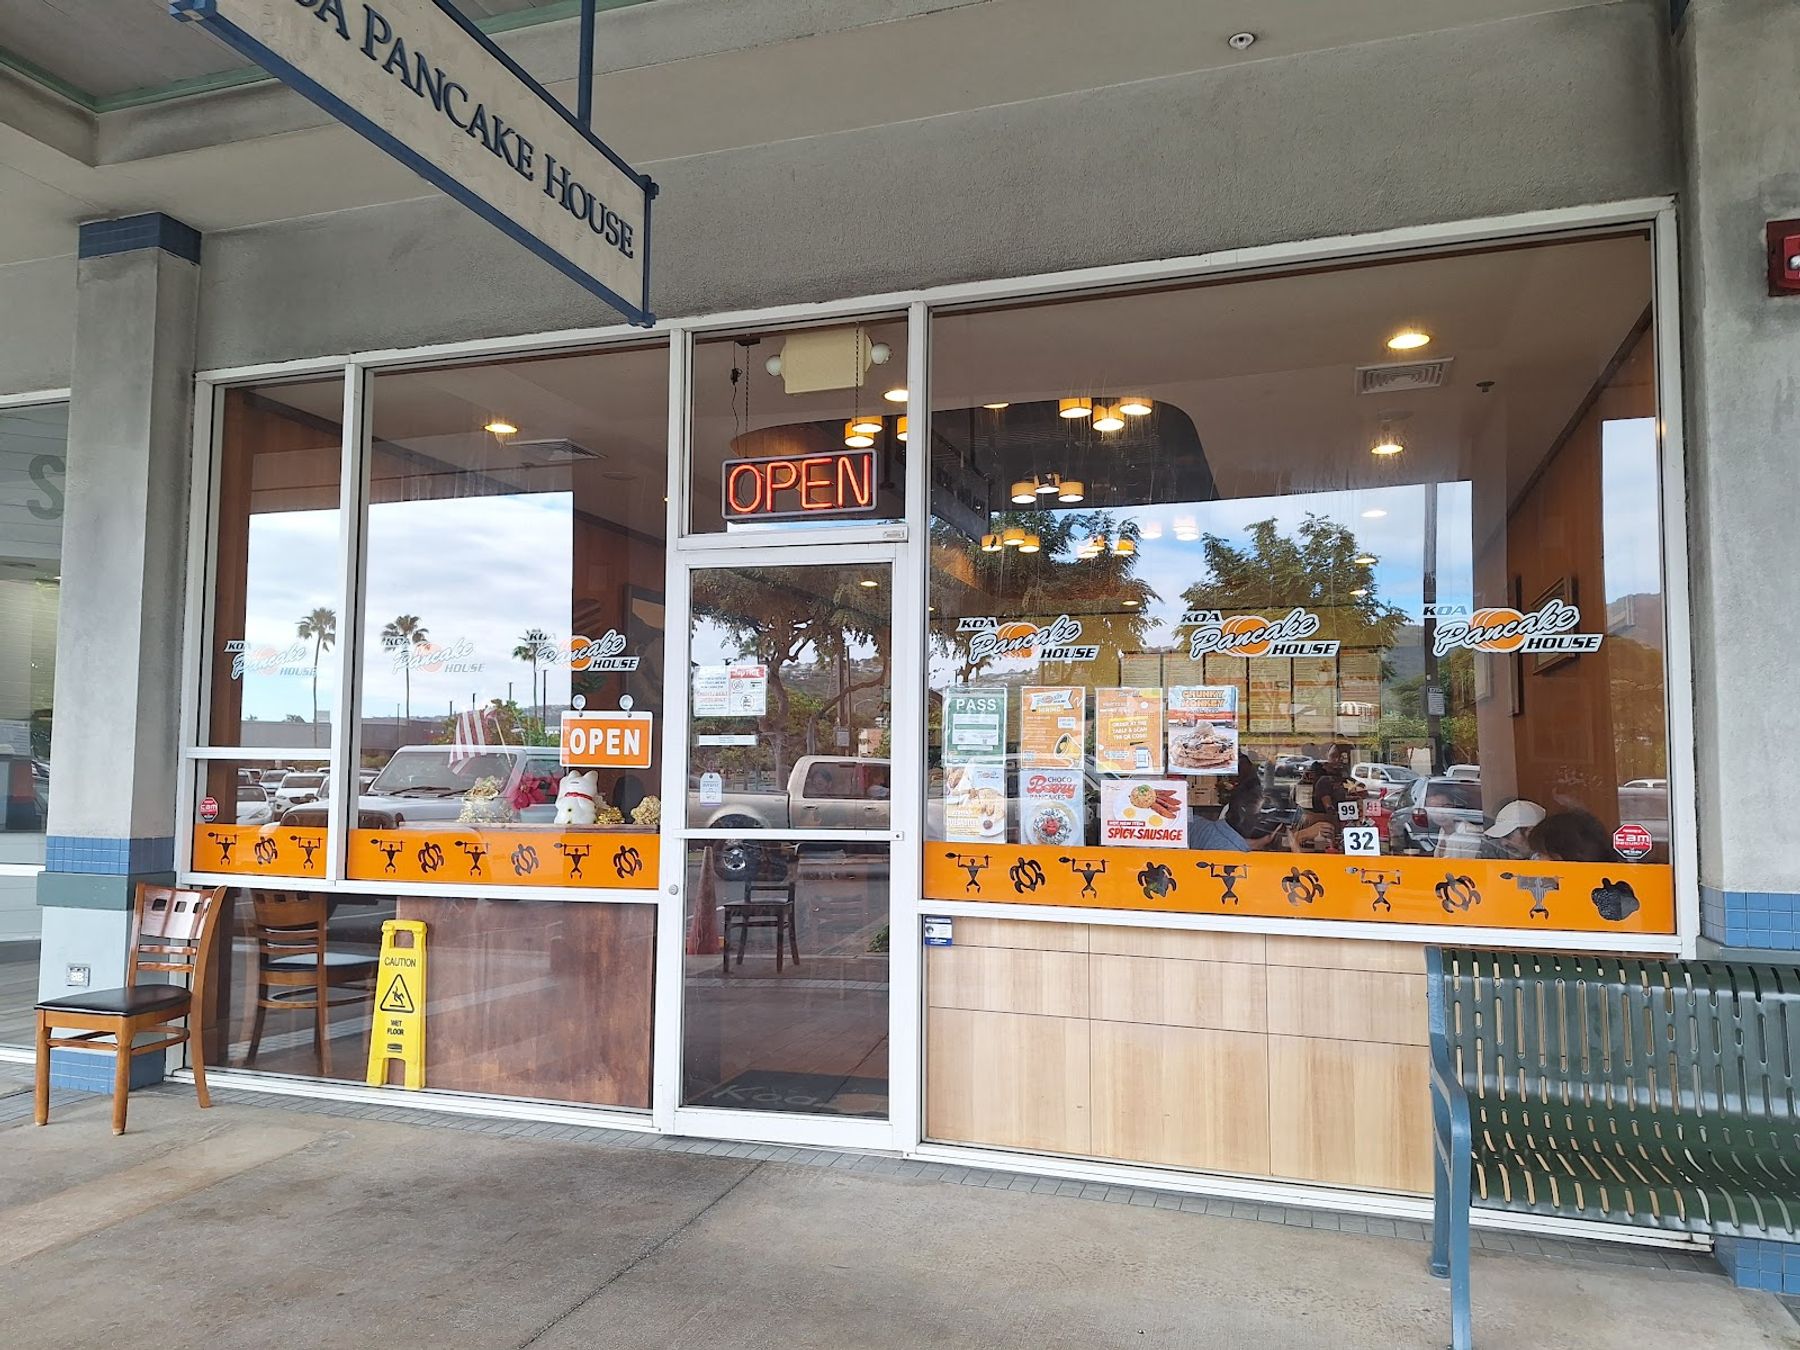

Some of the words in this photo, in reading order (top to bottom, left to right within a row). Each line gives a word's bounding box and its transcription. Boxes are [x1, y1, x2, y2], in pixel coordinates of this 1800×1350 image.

[360, 3, 535, 181] PANCAKE
[543, 153, 634, 259] HOUSE
[728, 454, 871, 513] OPEN
[1423, 604, 1468, 616] KOA
[961, 618, 997, 628] KOA
[1181, 612, 1221, 623] KOA
[1435, 599, 1578, 655] Pancake
[970, 615, 1081, 662] Pancake
[1191, 609, 1317, 658] Pancake
[1526, 636, 1599, 649] HOUSE
[536, 629, 626, 670] Pancake
[1040, 648, 1097, 659] HOUSE
[1271, 643, 1337, 655] HOUSE
[445, 663, 486, 673] HOUSE
[592, 659, 637, 669] HOUSE
[1182, 689, 1225, 699] CHUNKY
[956, 698, 997, 711] PASS
[569, 727, 641, 756] OPEN
[1340, 804, 1356, 816] 99
[1108, 827, 1135, 839] SPICY
[1136, 828, 1184, 841] SAUSAGE
[1349, 831, 1375, 851] 32
[384, 956, 417, 968] CAUTION
[390, 1019, 402, 1027] WET
[387, 1027, 404, 1036] FLOOR
